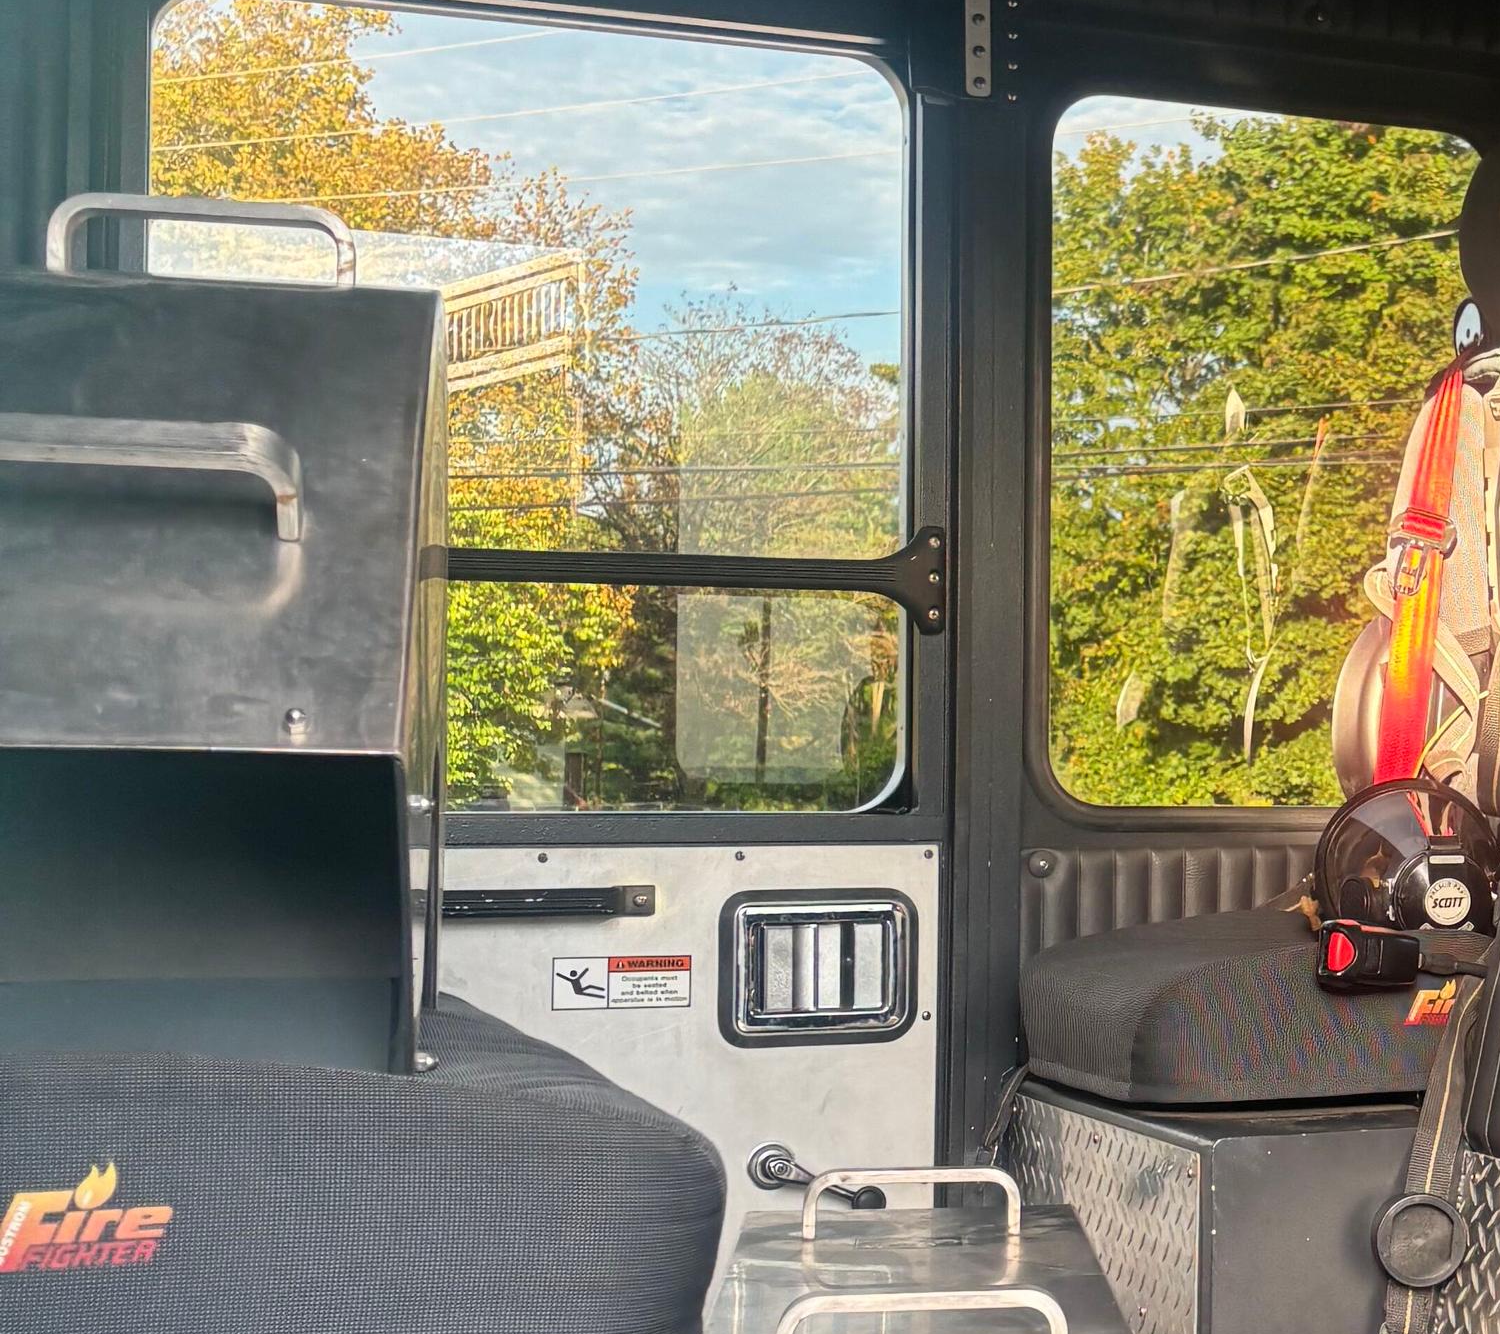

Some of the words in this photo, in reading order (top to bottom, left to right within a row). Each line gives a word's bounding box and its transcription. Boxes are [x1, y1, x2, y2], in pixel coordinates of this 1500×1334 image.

[1431, 896, 1467, 909] SCOTT
[627, 959, 684, 968] WARNING
[1403, 979, 1456, 1026] Fir
[0, 1163, 173, 1273] Fire
[21, 1239, 157, 1271] FIGHTER
